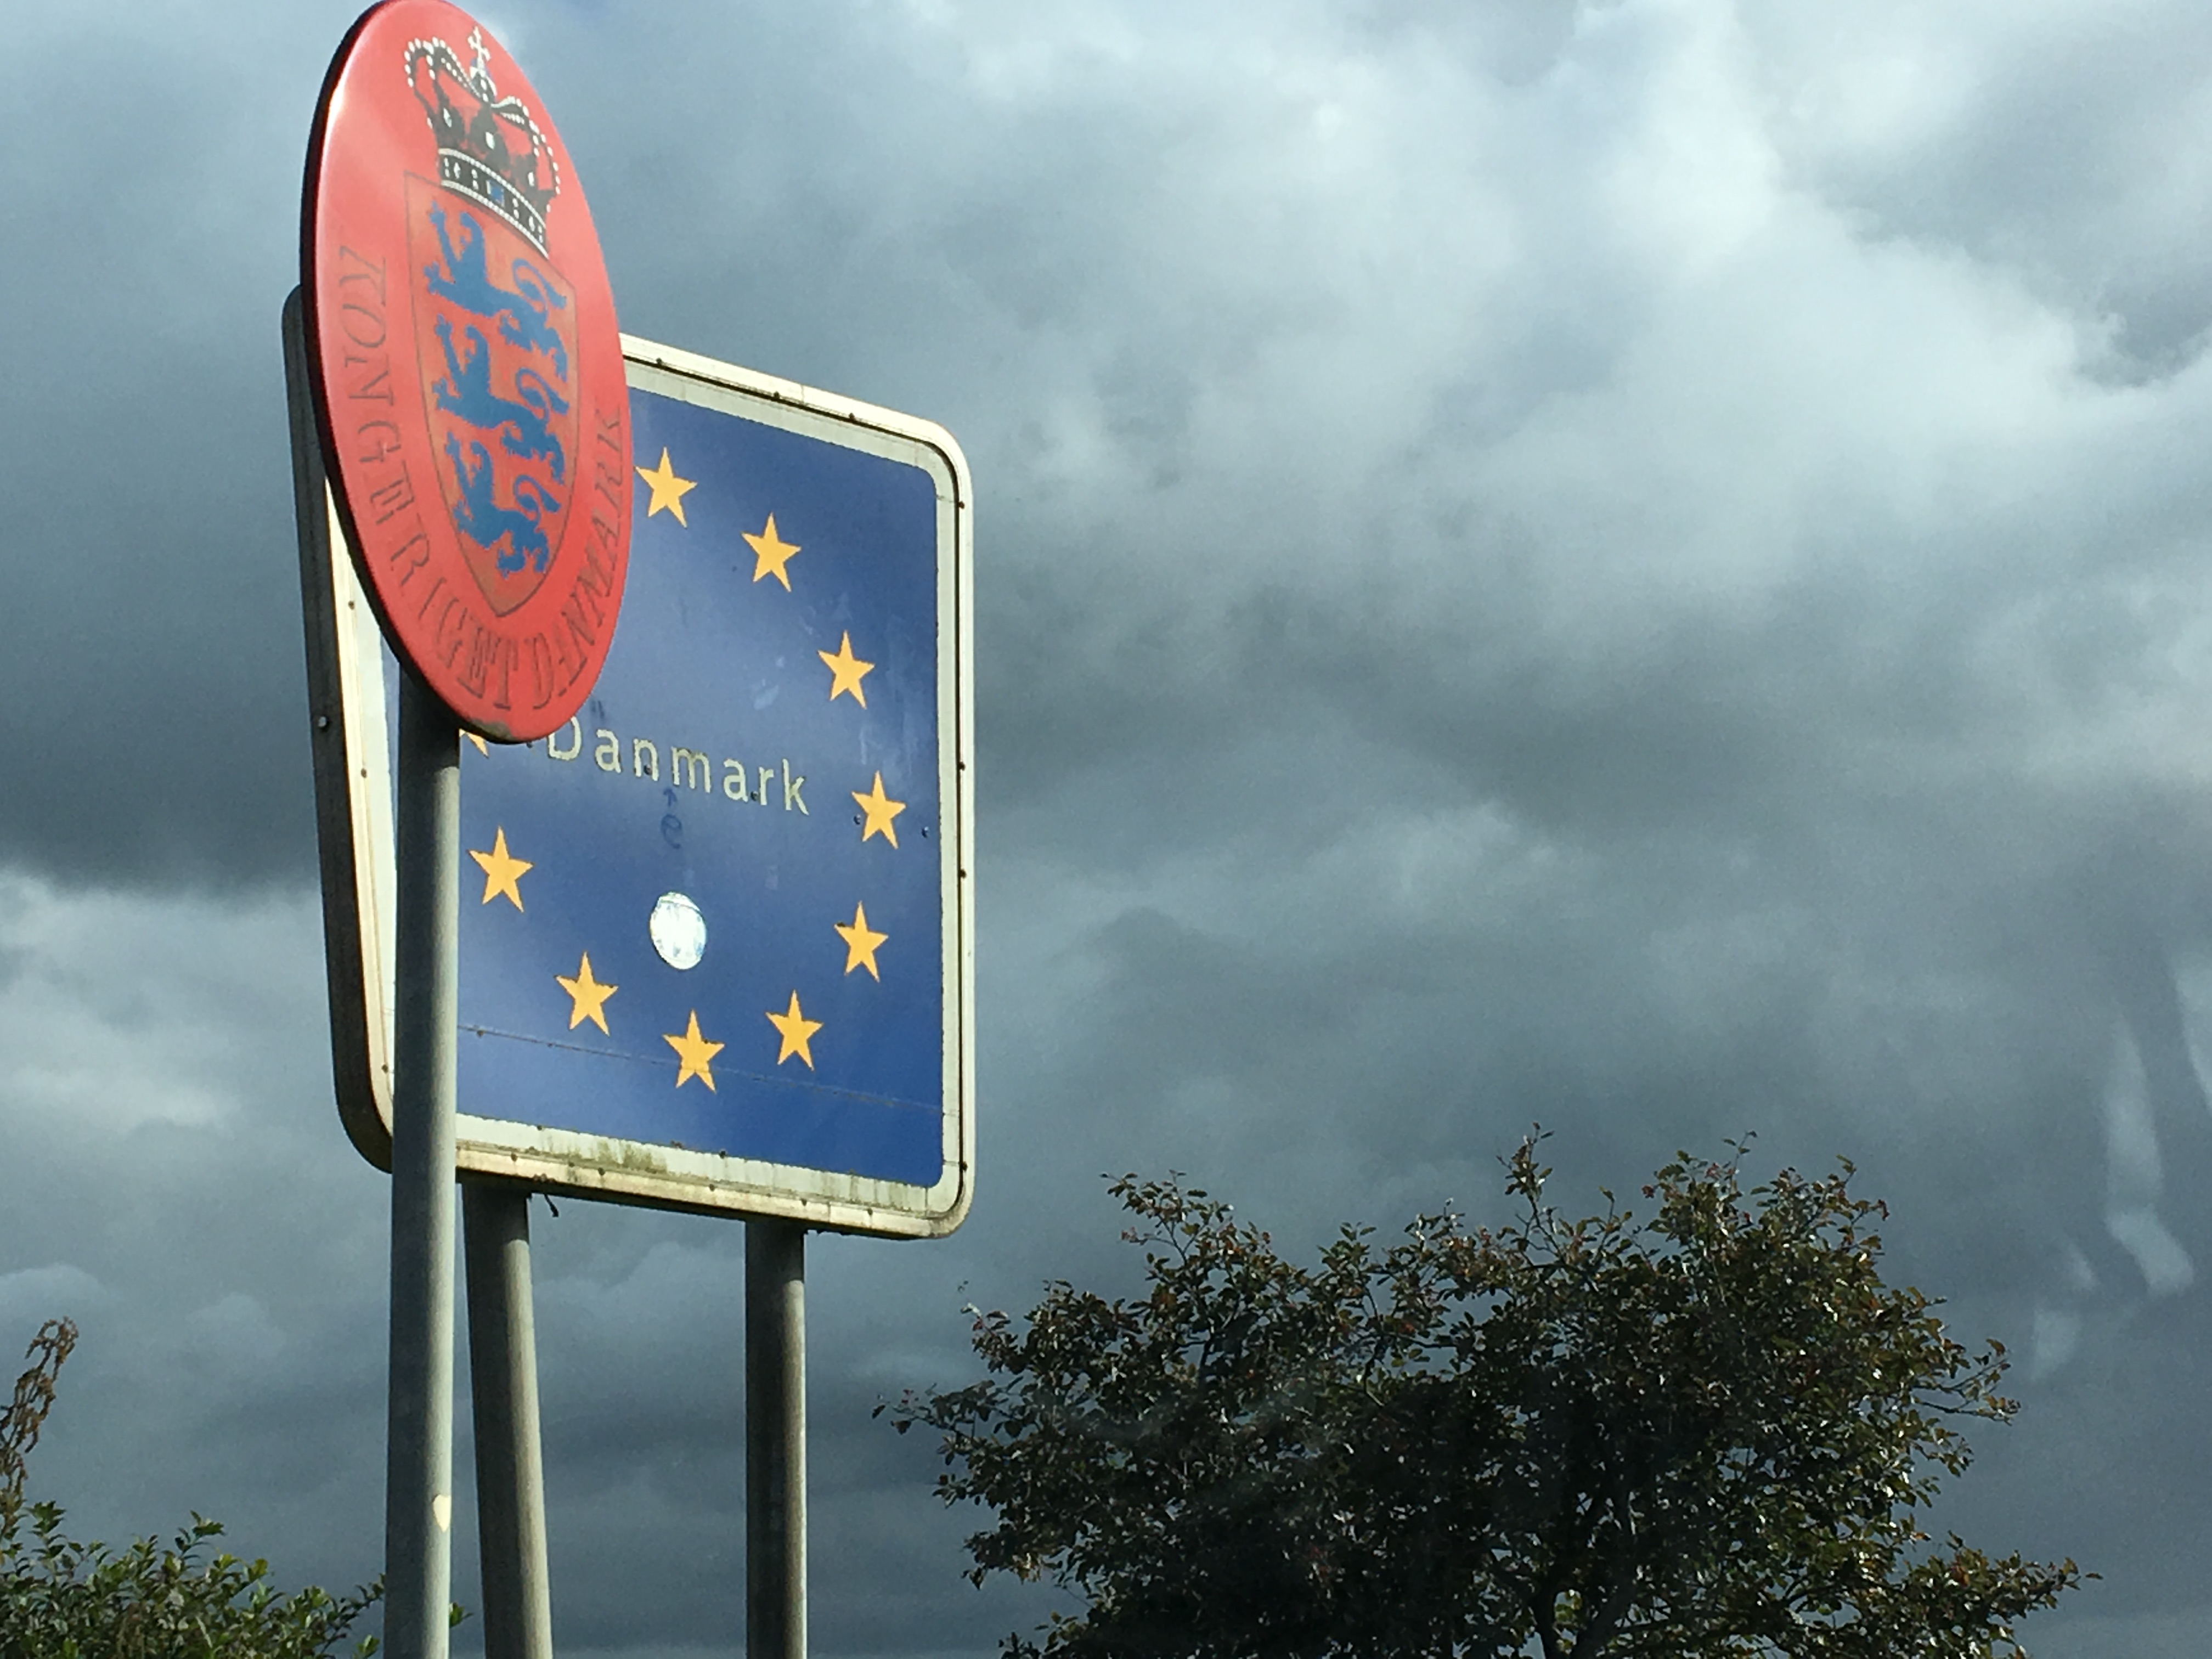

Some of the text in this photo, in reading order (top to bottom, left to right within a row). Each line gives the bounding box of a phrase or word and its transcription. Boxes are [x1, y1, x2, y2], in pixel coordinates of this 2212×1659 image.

[338, 245, 623, 710] KONGERIGET DANMARK
[548, 715, 809, 816] Danmark
